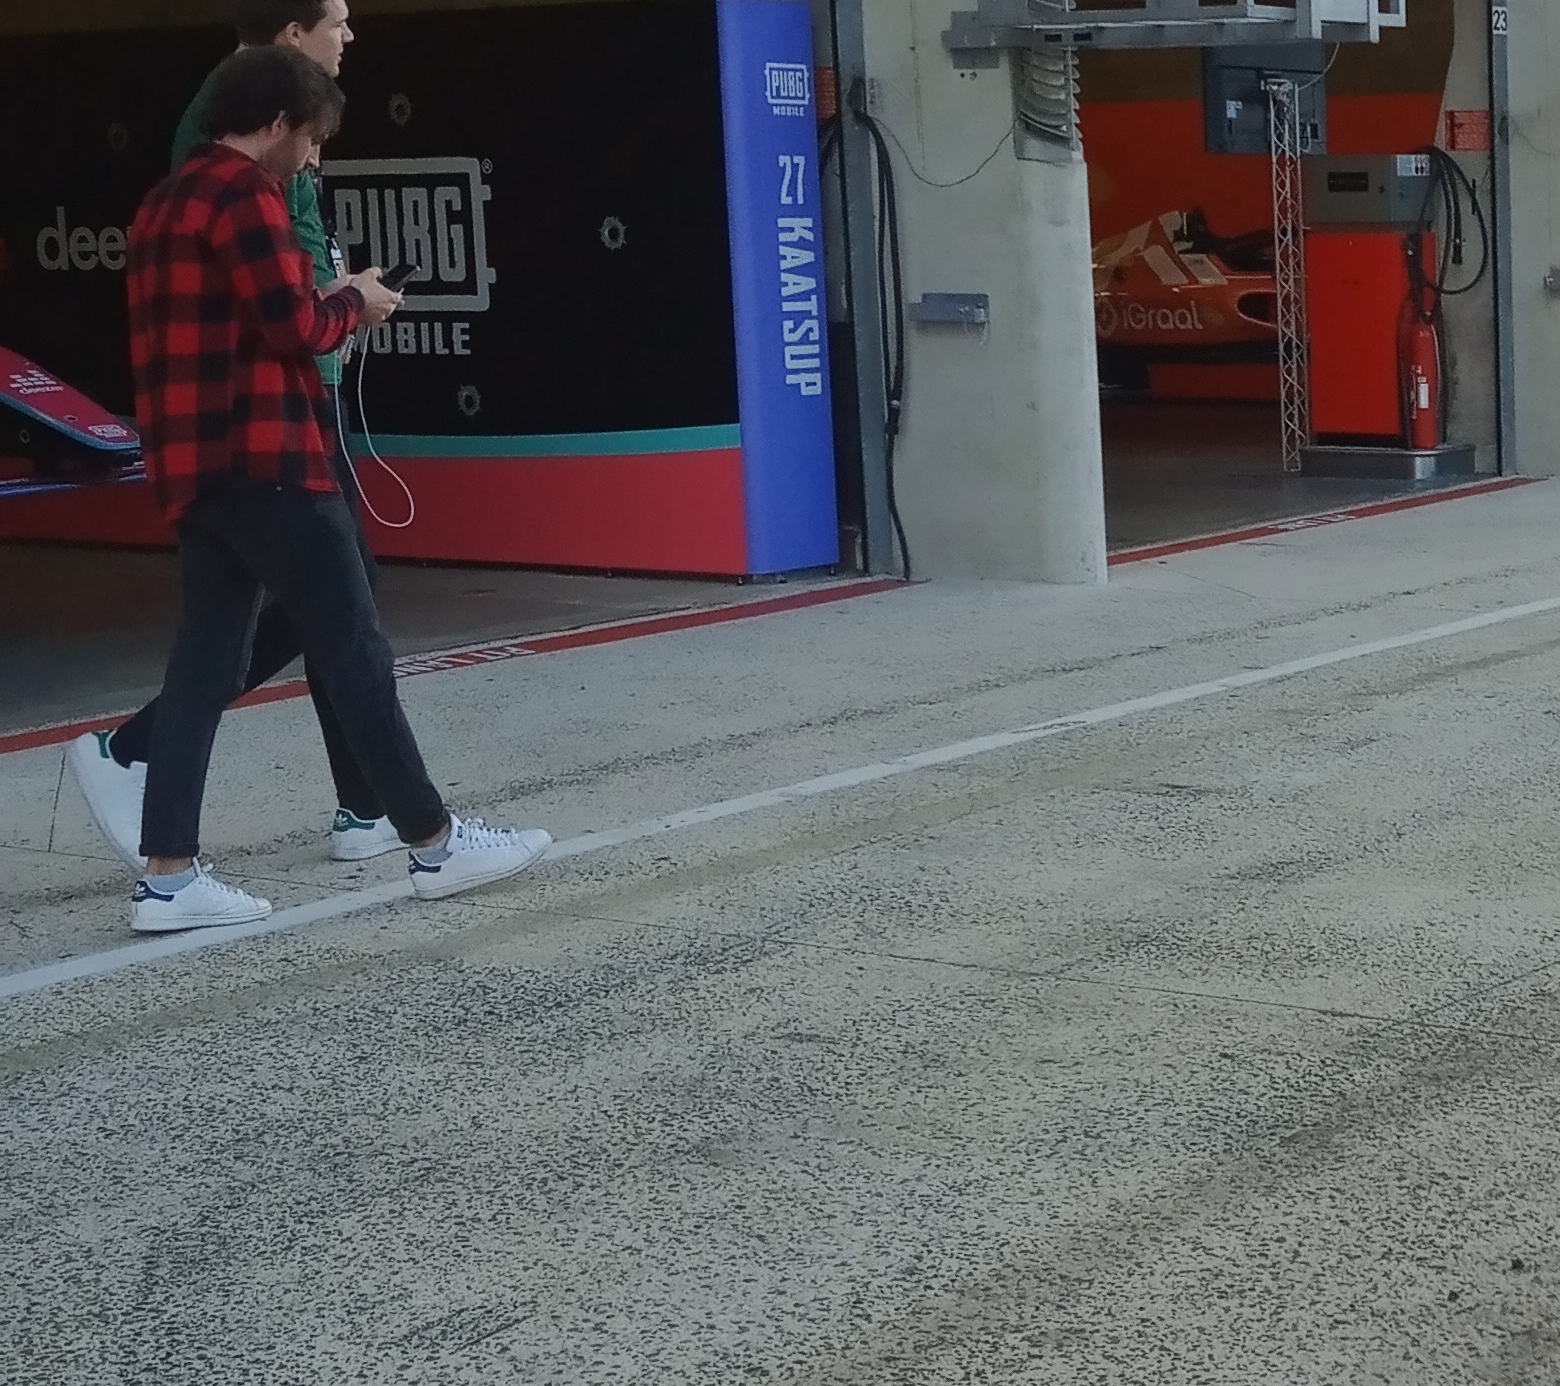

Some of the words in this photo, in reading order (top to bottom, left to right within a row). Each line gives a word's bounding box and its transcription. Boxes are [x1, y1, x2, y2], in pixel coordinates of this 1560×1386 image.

[1493, 10, 1508, 33] 23
[771, 70, 804, 98] PUBG
[773, 105, 805, 117] MOBILE
[778, 155, 806, 205] 27
[36, 206, 133, 271] dee
[334, 186, 467, 282] PUBG
[777, 216, 823, 396] KAATSUP
[1123, 300, 1204, 330] iGraal
